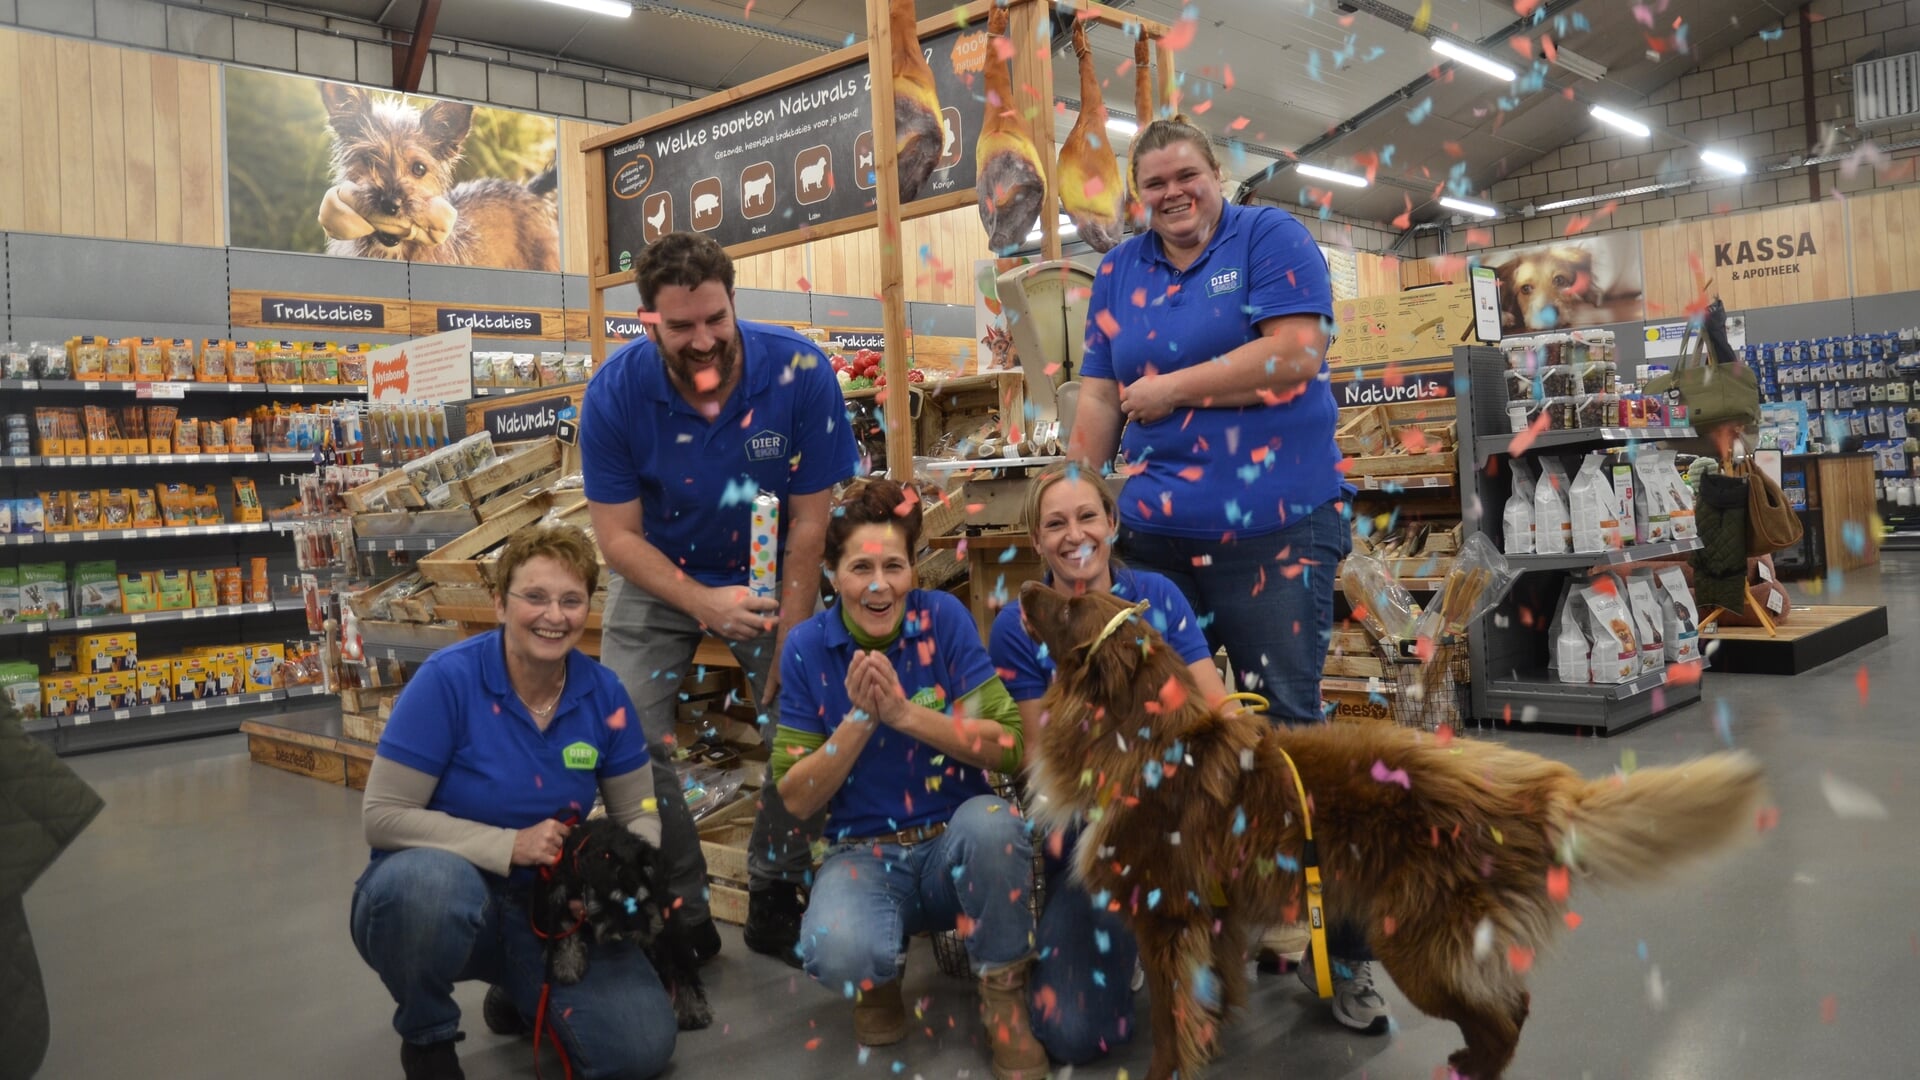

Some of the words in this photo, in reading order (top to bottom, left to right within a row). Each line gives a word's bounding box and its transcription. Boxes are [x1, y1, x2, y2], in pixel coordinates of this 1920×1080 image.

[656, 129, 707, 158] Welke
[712, 109, 775, 141] soorten
[780, 79, 857, 117] Naturals
[745, 136, 774, 151] heerlijke
[776, 125, 811, 141] traktaties
[813, 119, 829, 130] voor
[830, 115, 837, 126] je
[1714, 231, 1817, 268] KASSA
[1211, 271, 1238, 287] DIER
[1732, 271, 1740, 281] &
[1743, 263, 1800, 280] APOTHEEK
[273, 303, 373, 321] Traktaties
[446, 313, 532, 329] Traktaties
[836, 335, 885, 347] Traktatie
[1345, 379, 1439, 404] Naturals
[497, 406, 556, 434] Naturals
[752, 436, 780, 449] DIER
